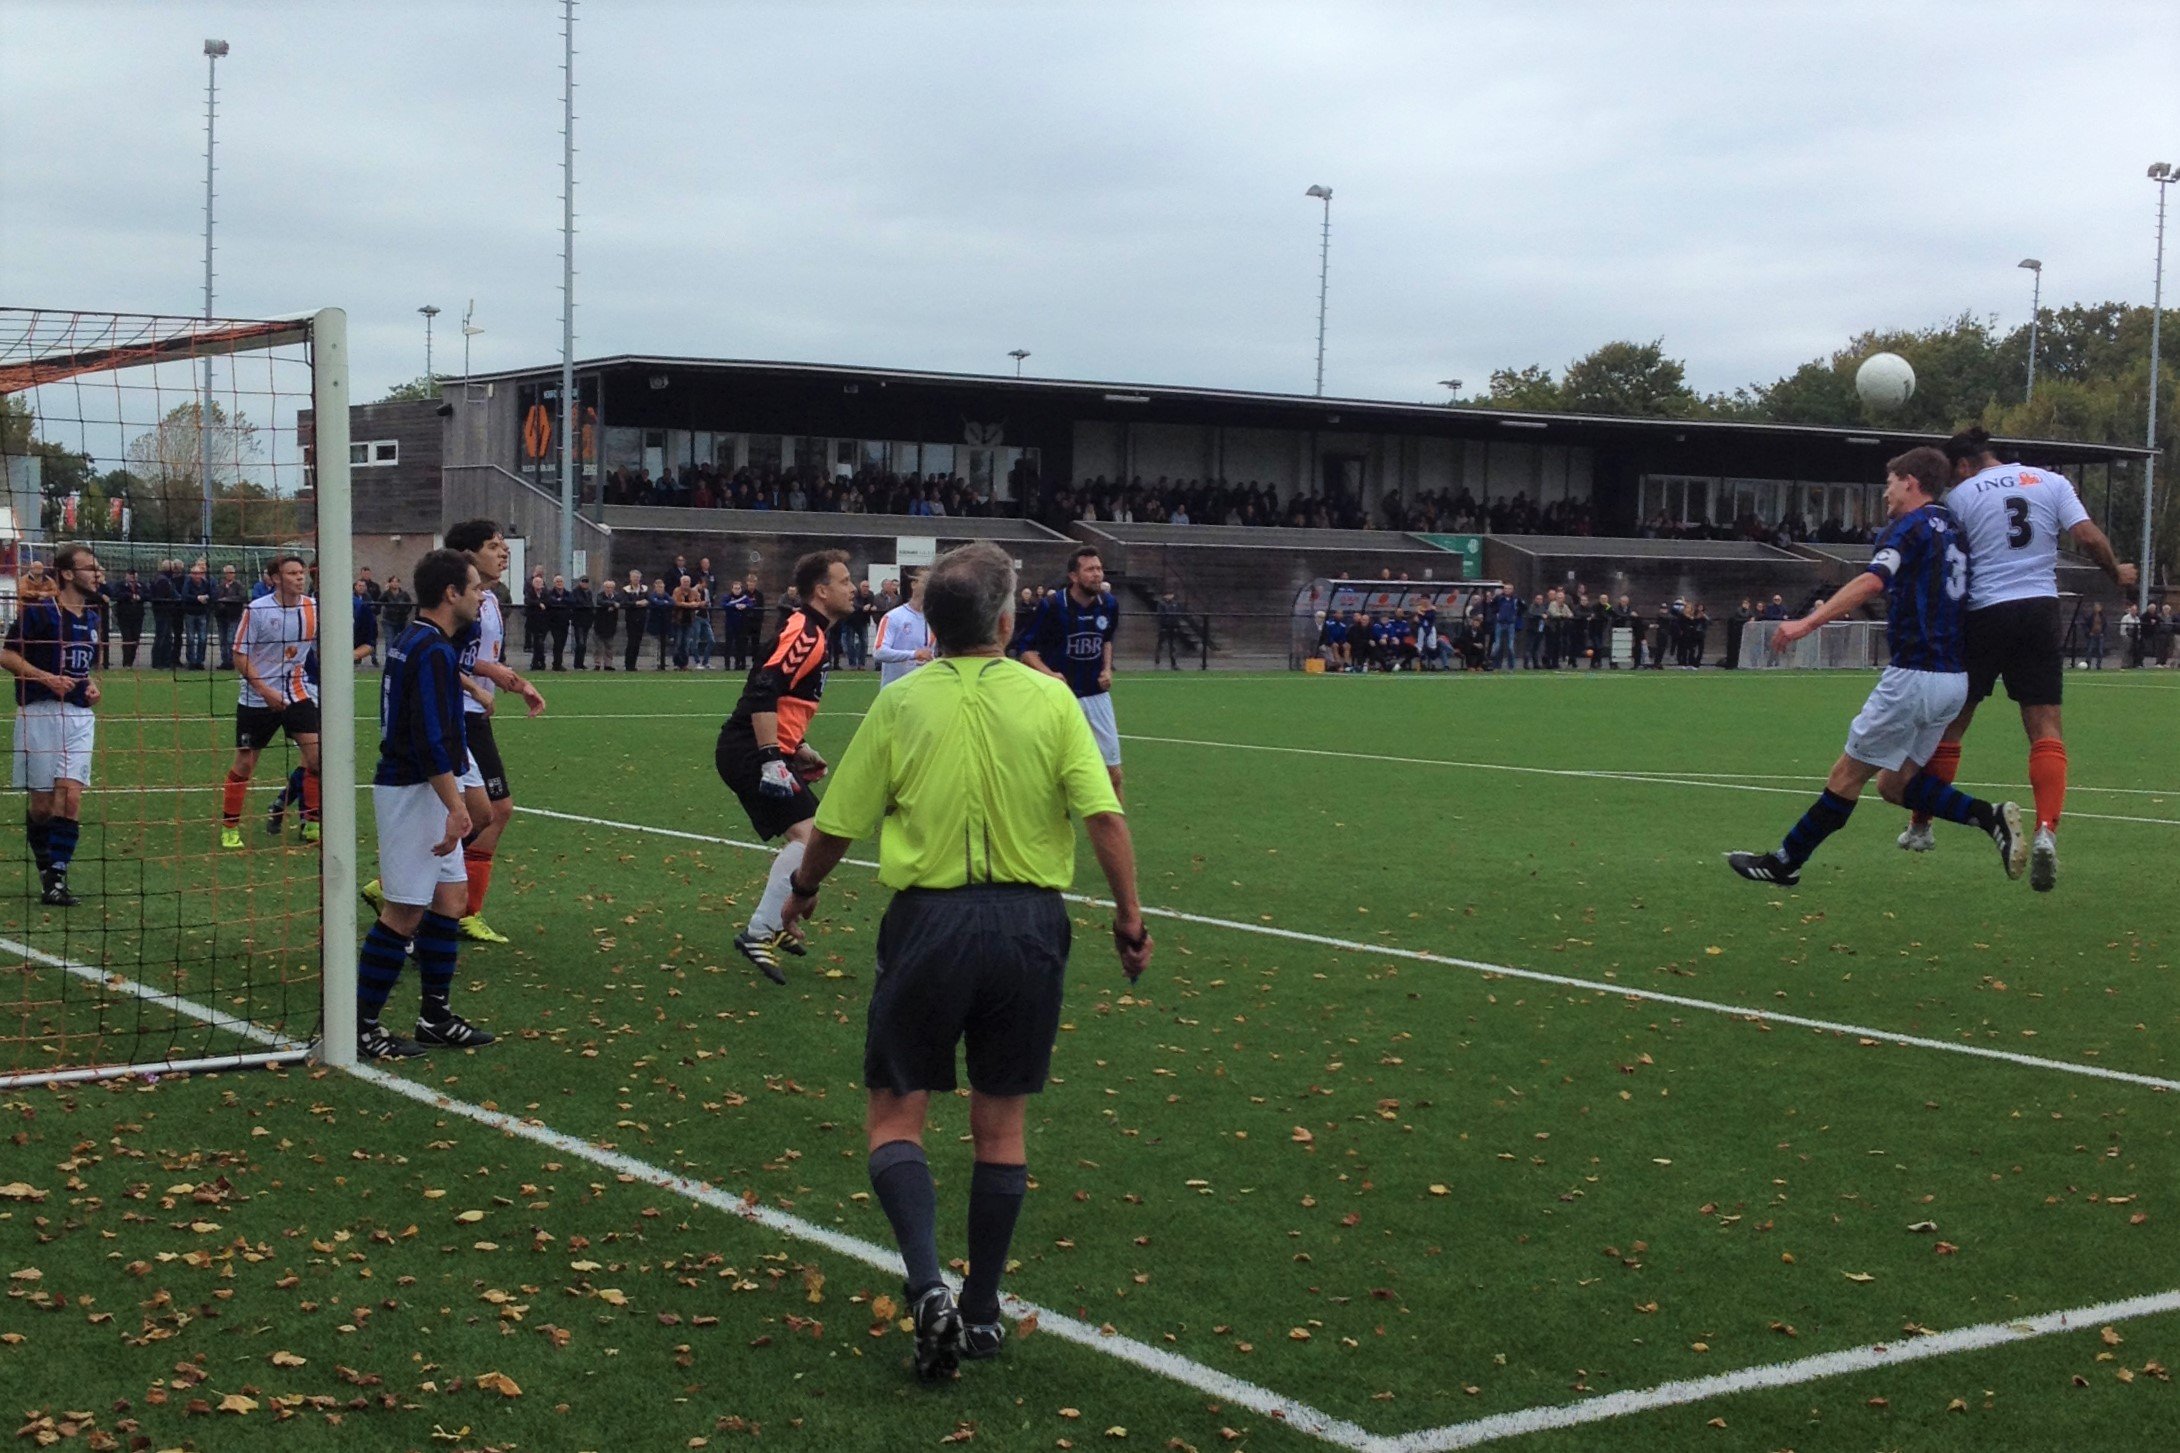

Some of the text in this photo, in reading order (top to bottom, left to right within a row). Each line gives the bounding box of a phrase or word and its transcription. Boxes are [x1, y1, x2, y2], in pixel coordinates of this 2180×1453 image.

[1975, 476, 2015, 493] ING
[2003, 495, 2035, 550] 3
[1945, 543, 1967, 600] 3
[1066, 637, 1102, 655] HBR
